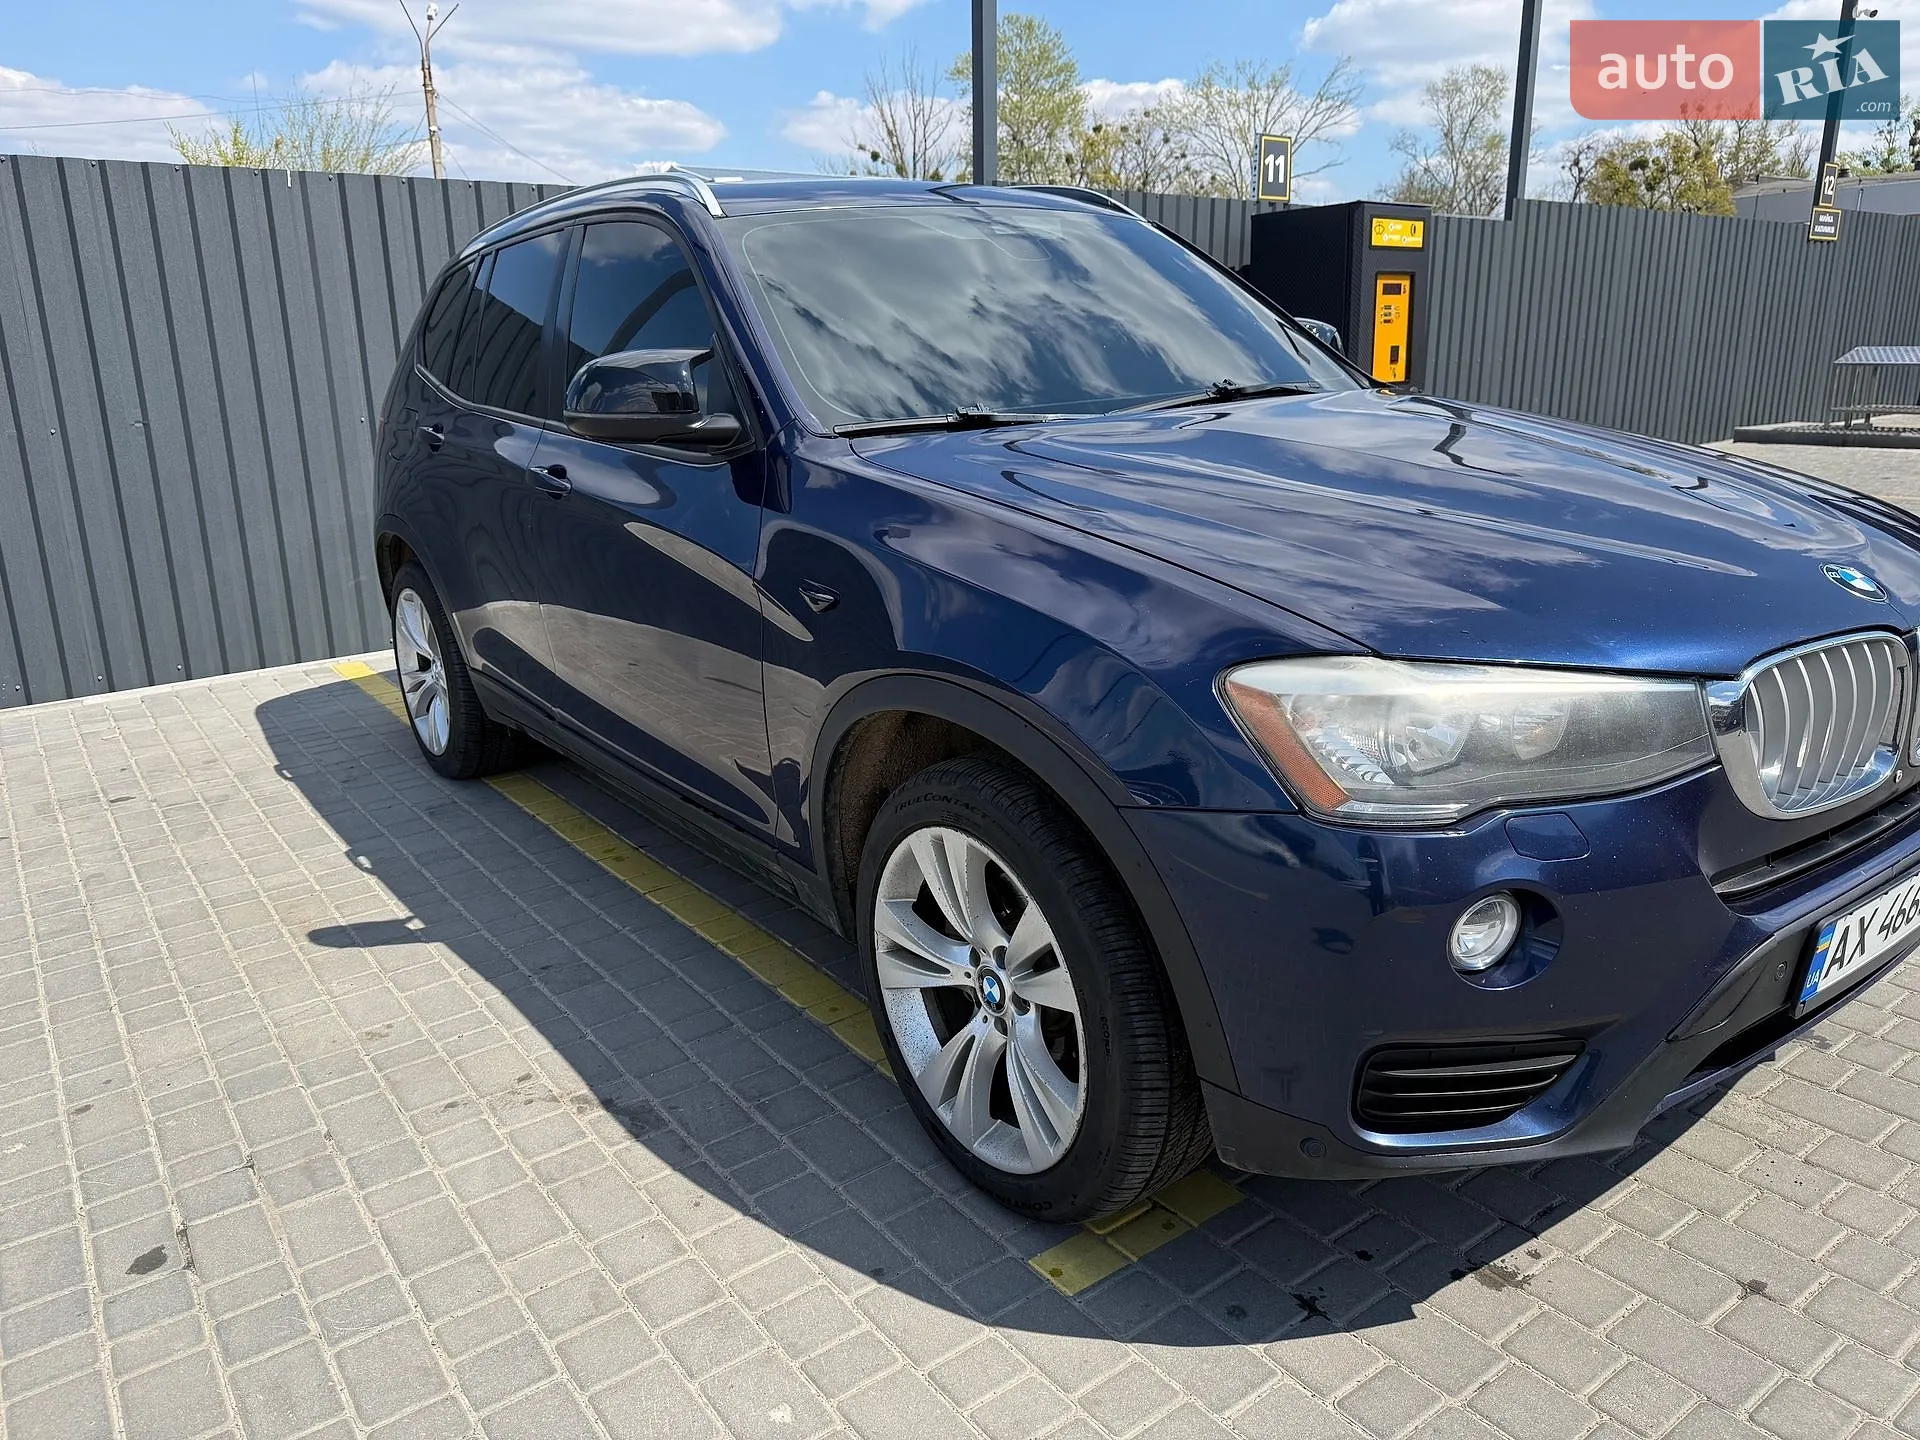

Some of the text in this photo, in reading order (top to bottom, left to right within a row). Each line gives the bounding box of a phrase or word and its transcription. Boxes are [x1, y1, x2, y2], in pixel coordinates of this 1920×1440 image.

[1264, 153, 1285, 184] 11
[1824, 175, 1835, 196] 12
[1823, 884, 1920, 979] AX 466
[1806, 969, 1821, 988] UA
